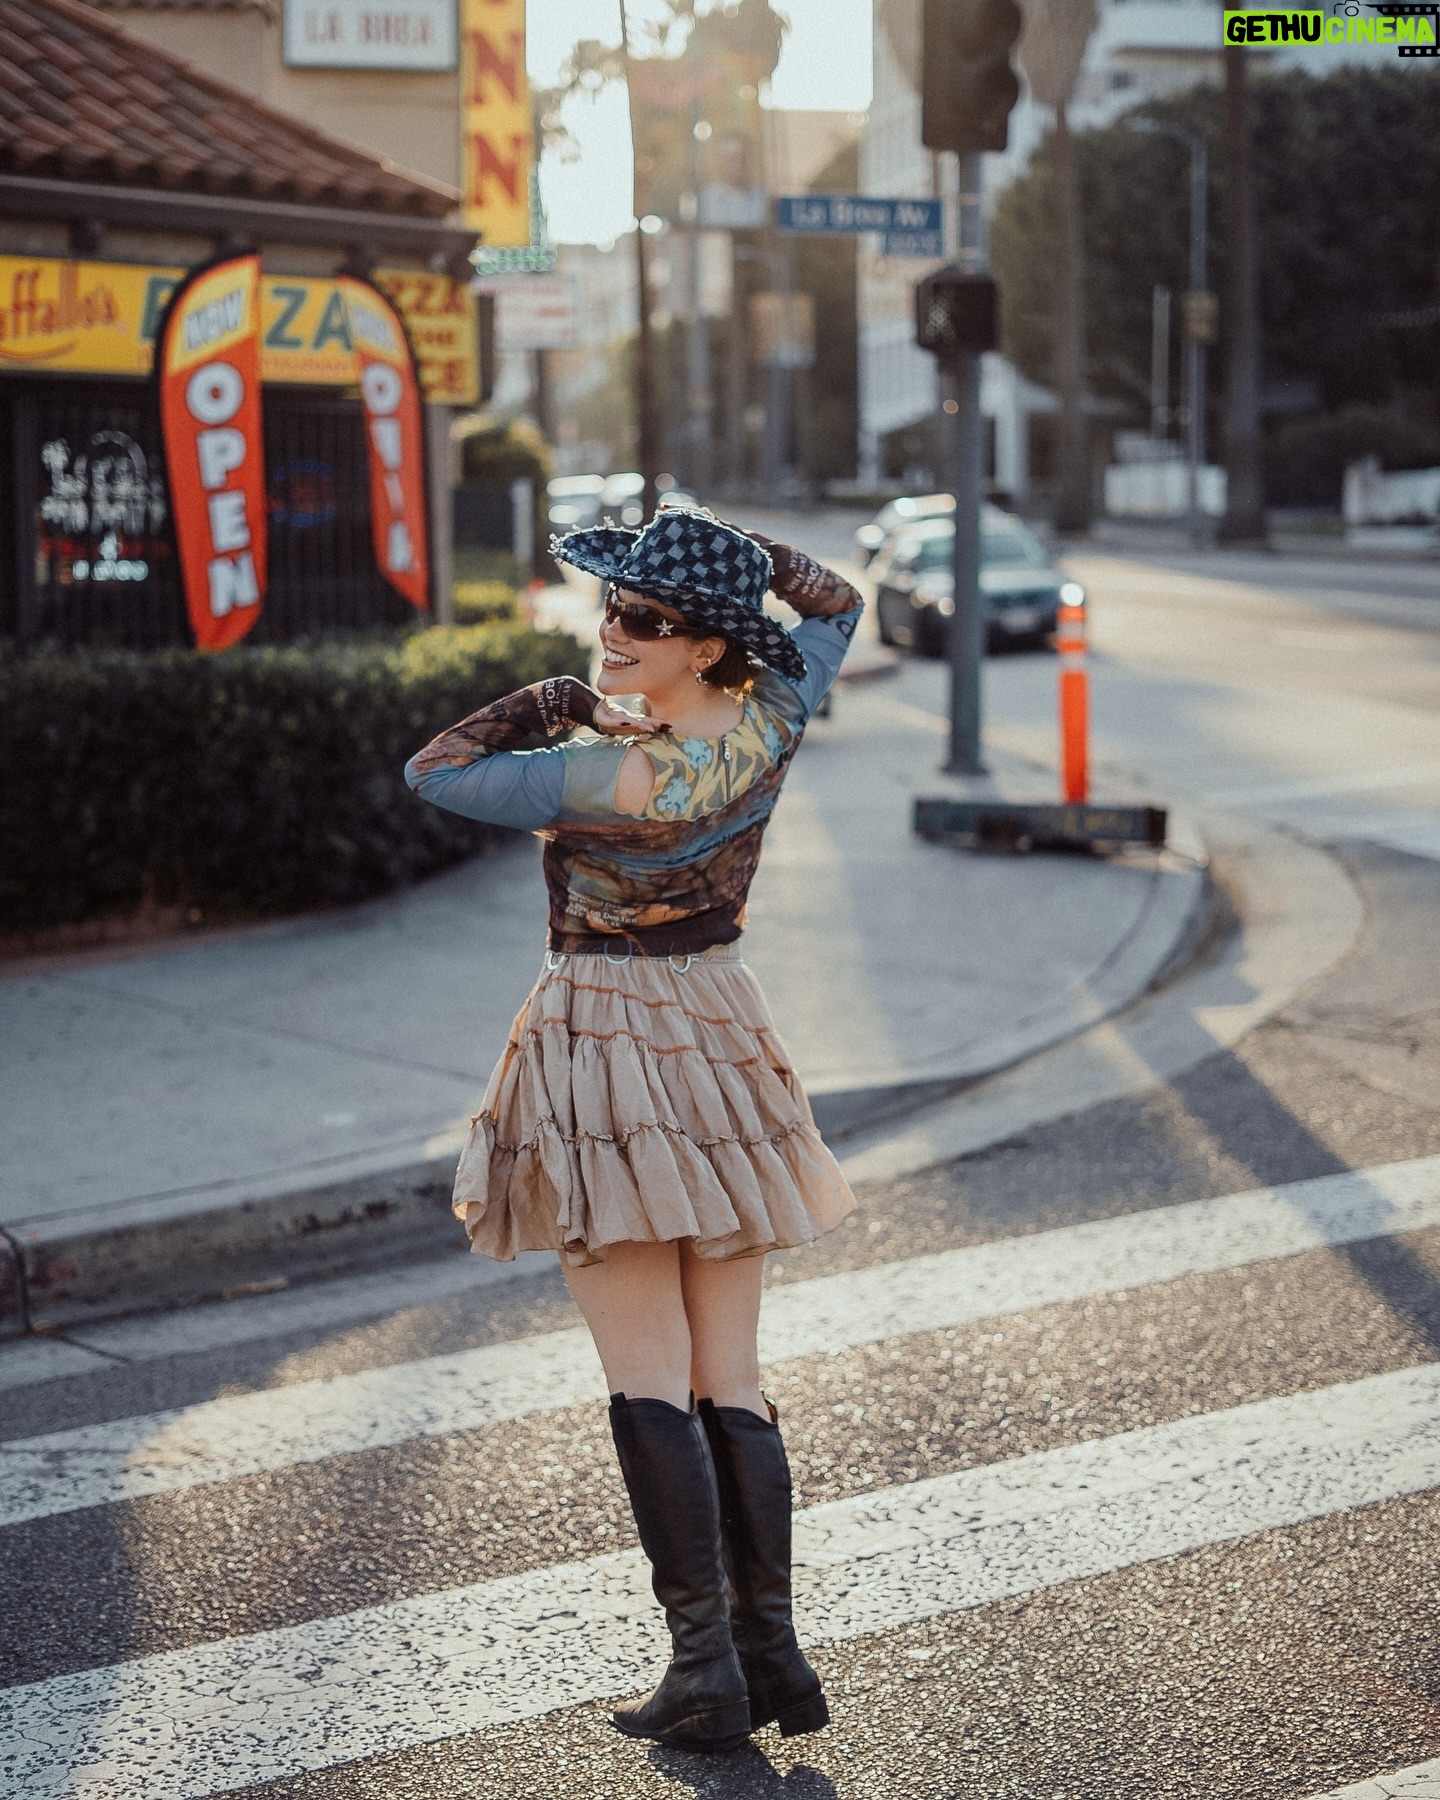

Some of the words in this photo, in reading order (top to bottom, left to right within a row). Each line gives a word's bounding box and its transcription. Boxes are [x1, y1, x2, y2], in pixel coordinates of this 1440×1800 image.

[467, 0, 521, 208] NN
[790, 200, 826, 225] La
[140, 275, 353, 352] PZA
[183, 289, 245, 350] NEW
[185, 361, 260, 618] OPEN
